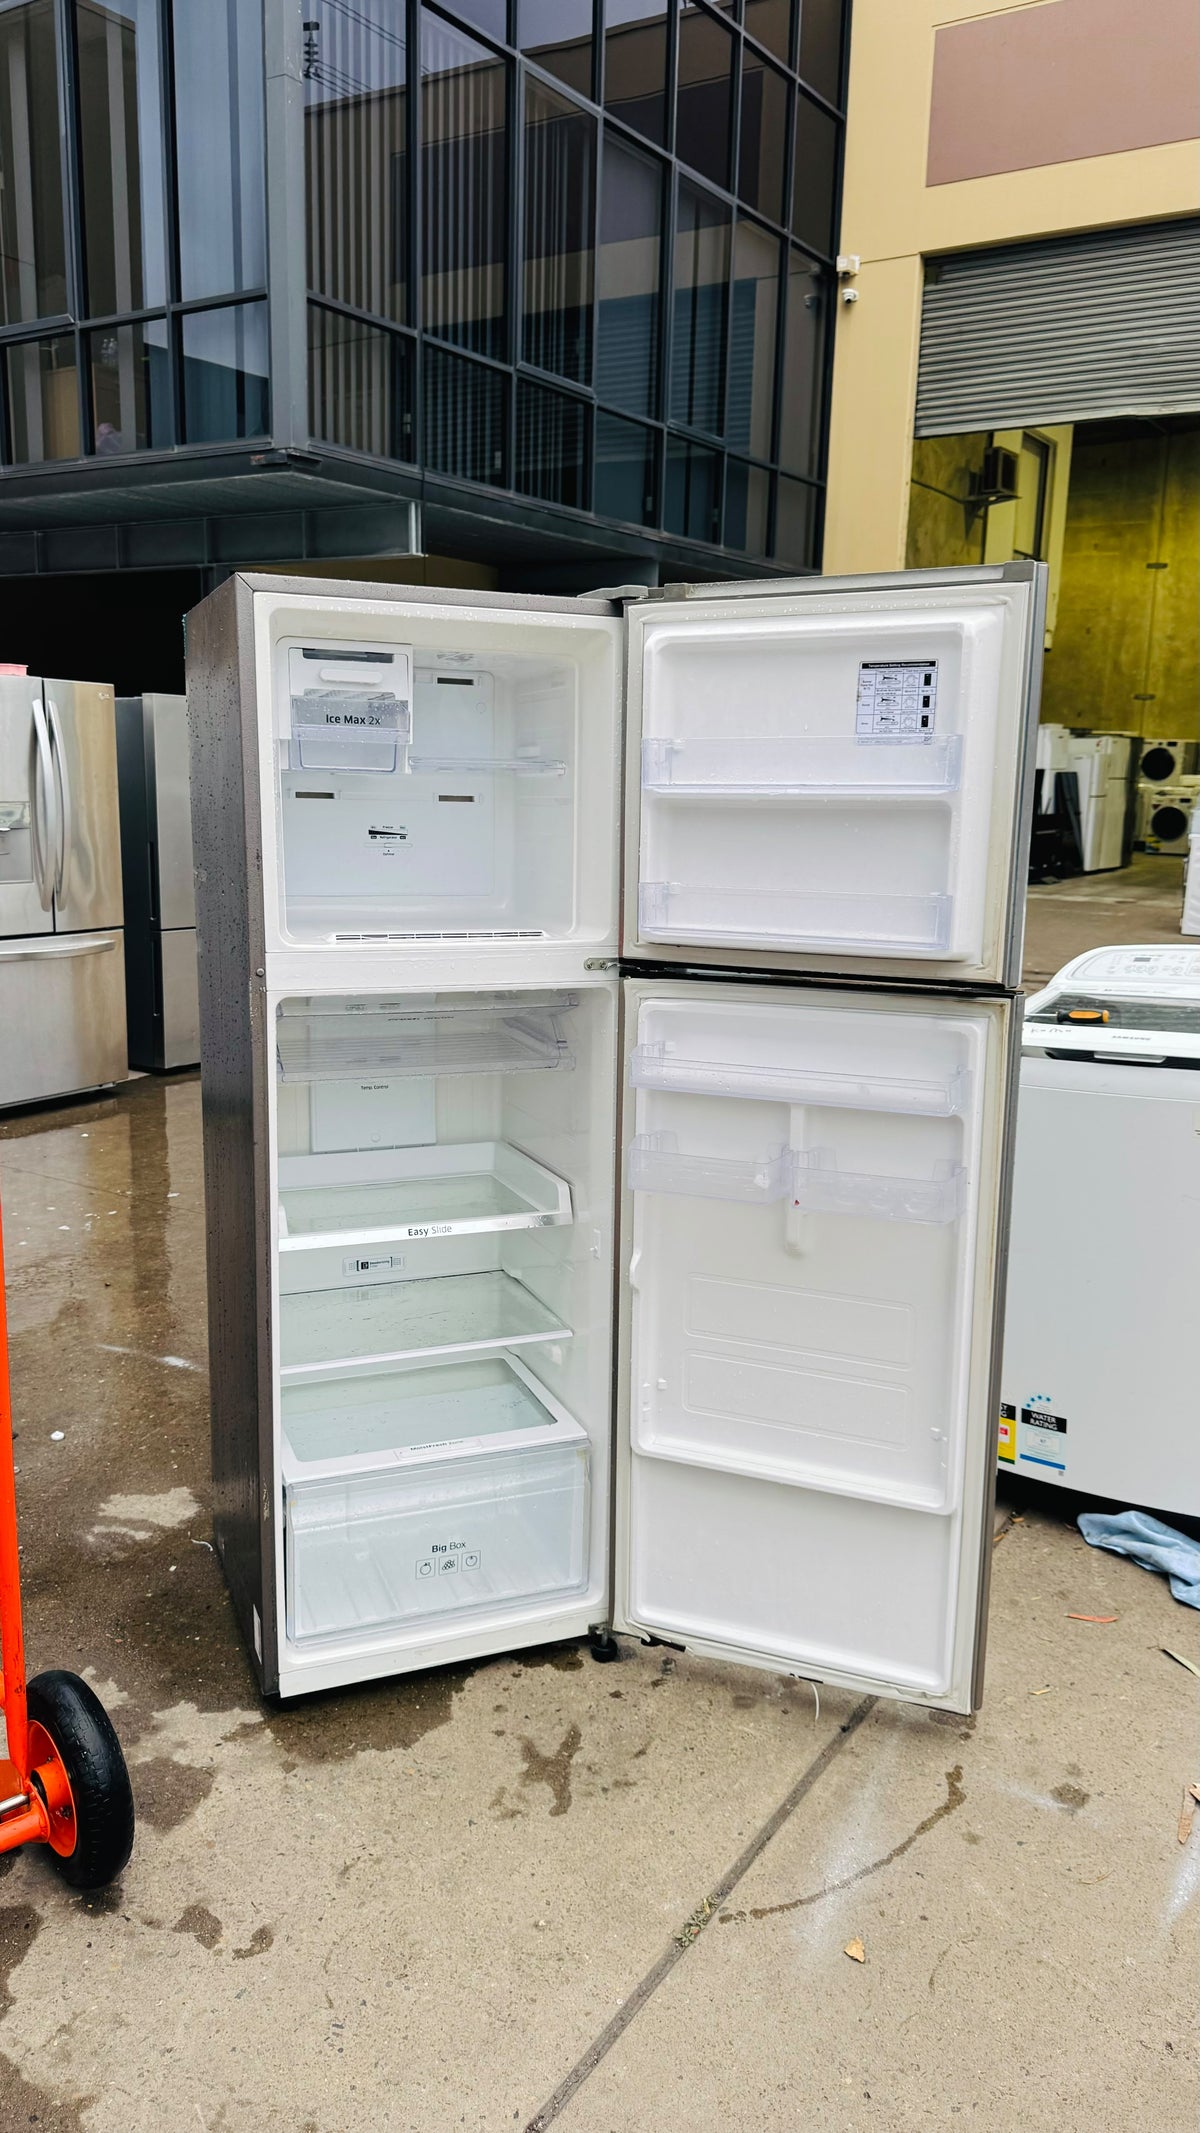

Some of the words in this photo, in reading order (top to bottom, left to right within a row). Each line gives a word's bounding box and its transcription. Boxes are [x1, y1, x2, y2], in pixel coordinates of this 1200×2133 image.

[326, 714, 341, 724] Ice
[344, 714, 366, 725] Max
[368, 715, 381, 726] 2x
[407, 1228, 429, 1237] Easy
[431, 1224, 453, 1235] Slide
[1029, 1417, 1058, 1431] RATING
[1031, 1411, 1057, 1424] WATER
[431, 1544, 447, 1553] Big
[449, 1541, 466, 1551] Box
